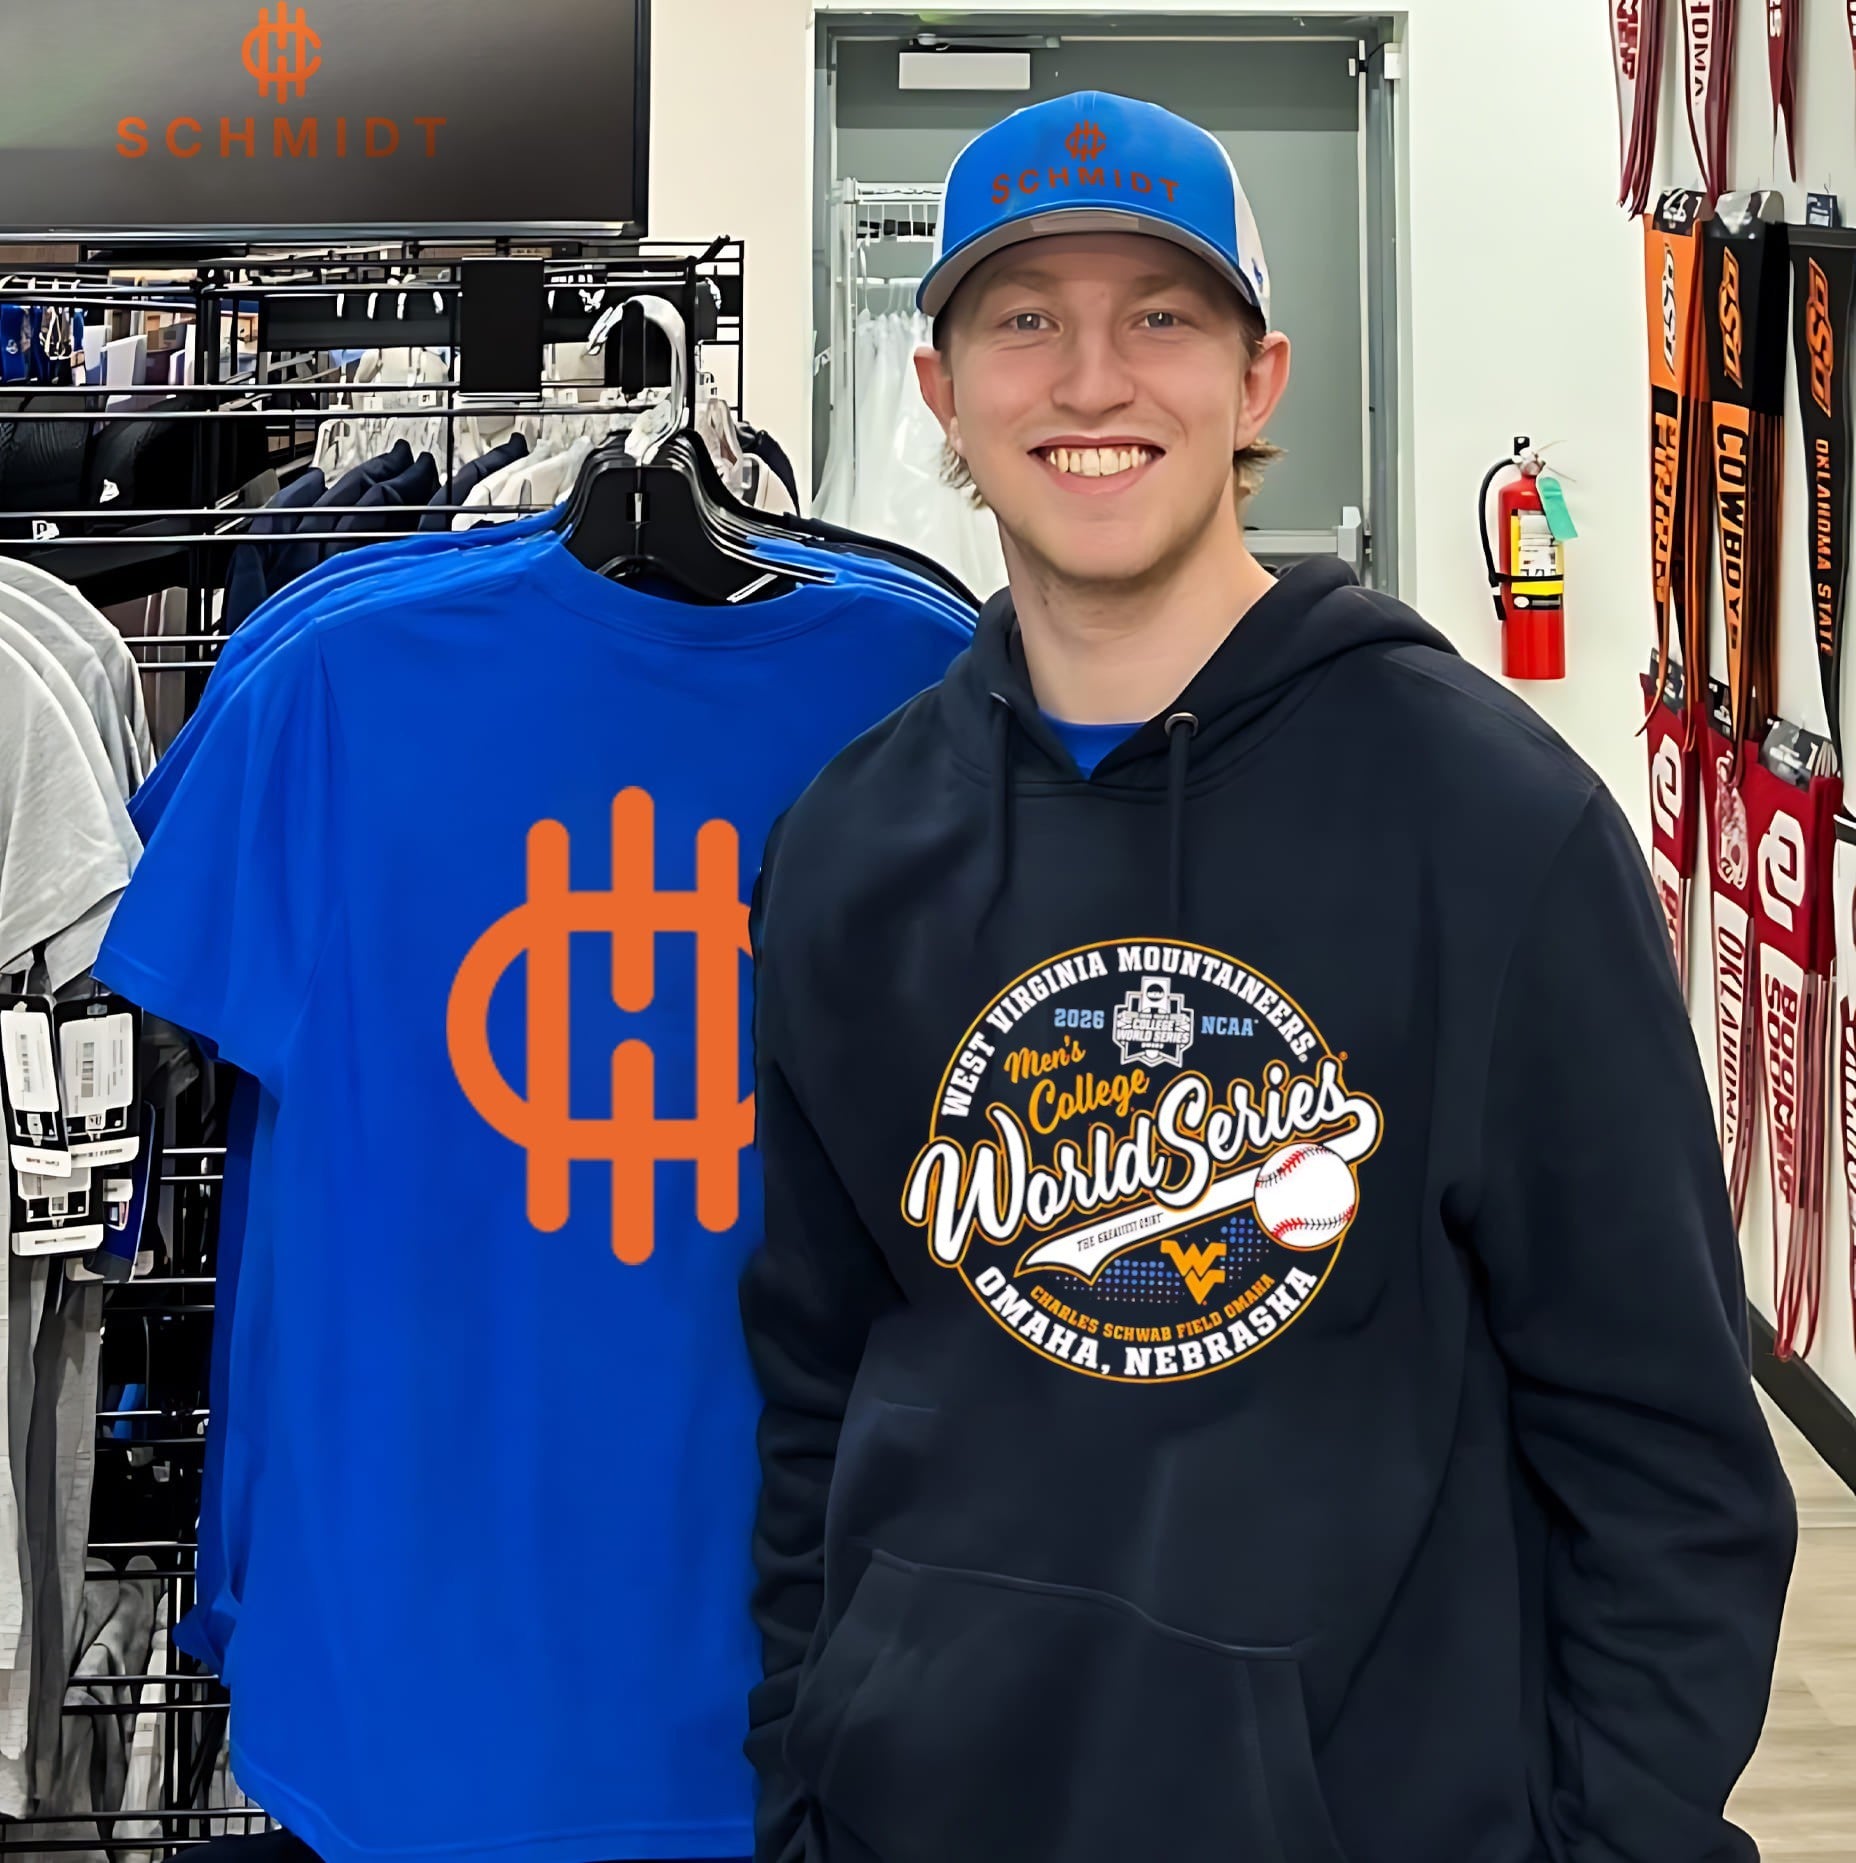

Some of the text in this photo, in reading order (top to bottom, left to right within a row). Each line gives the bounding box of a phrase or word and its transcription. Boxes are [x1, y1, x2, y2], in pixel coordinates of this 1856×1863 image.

[115, 115, 447, 159] SCHMIDT
[991, 166, 1179, 205] SCHMIDT
[941, 1031, 996, 1118] WEST
[985, 950, 1109, 1035] VIRGINIA
[1053, 1008, 1105, 1030] 2026
[1201, 1015, 1254, 1037] NCAA
[1003, 1034, 1087, 1084] Men's
[1028, 1068, 1150, 1135] College
[973, 1265, 1319, 1377] OMAHA, NEBRASKA
[1029, 1272, 1276, 1343] CHARLES SCHWAB FIELD OMAHA
